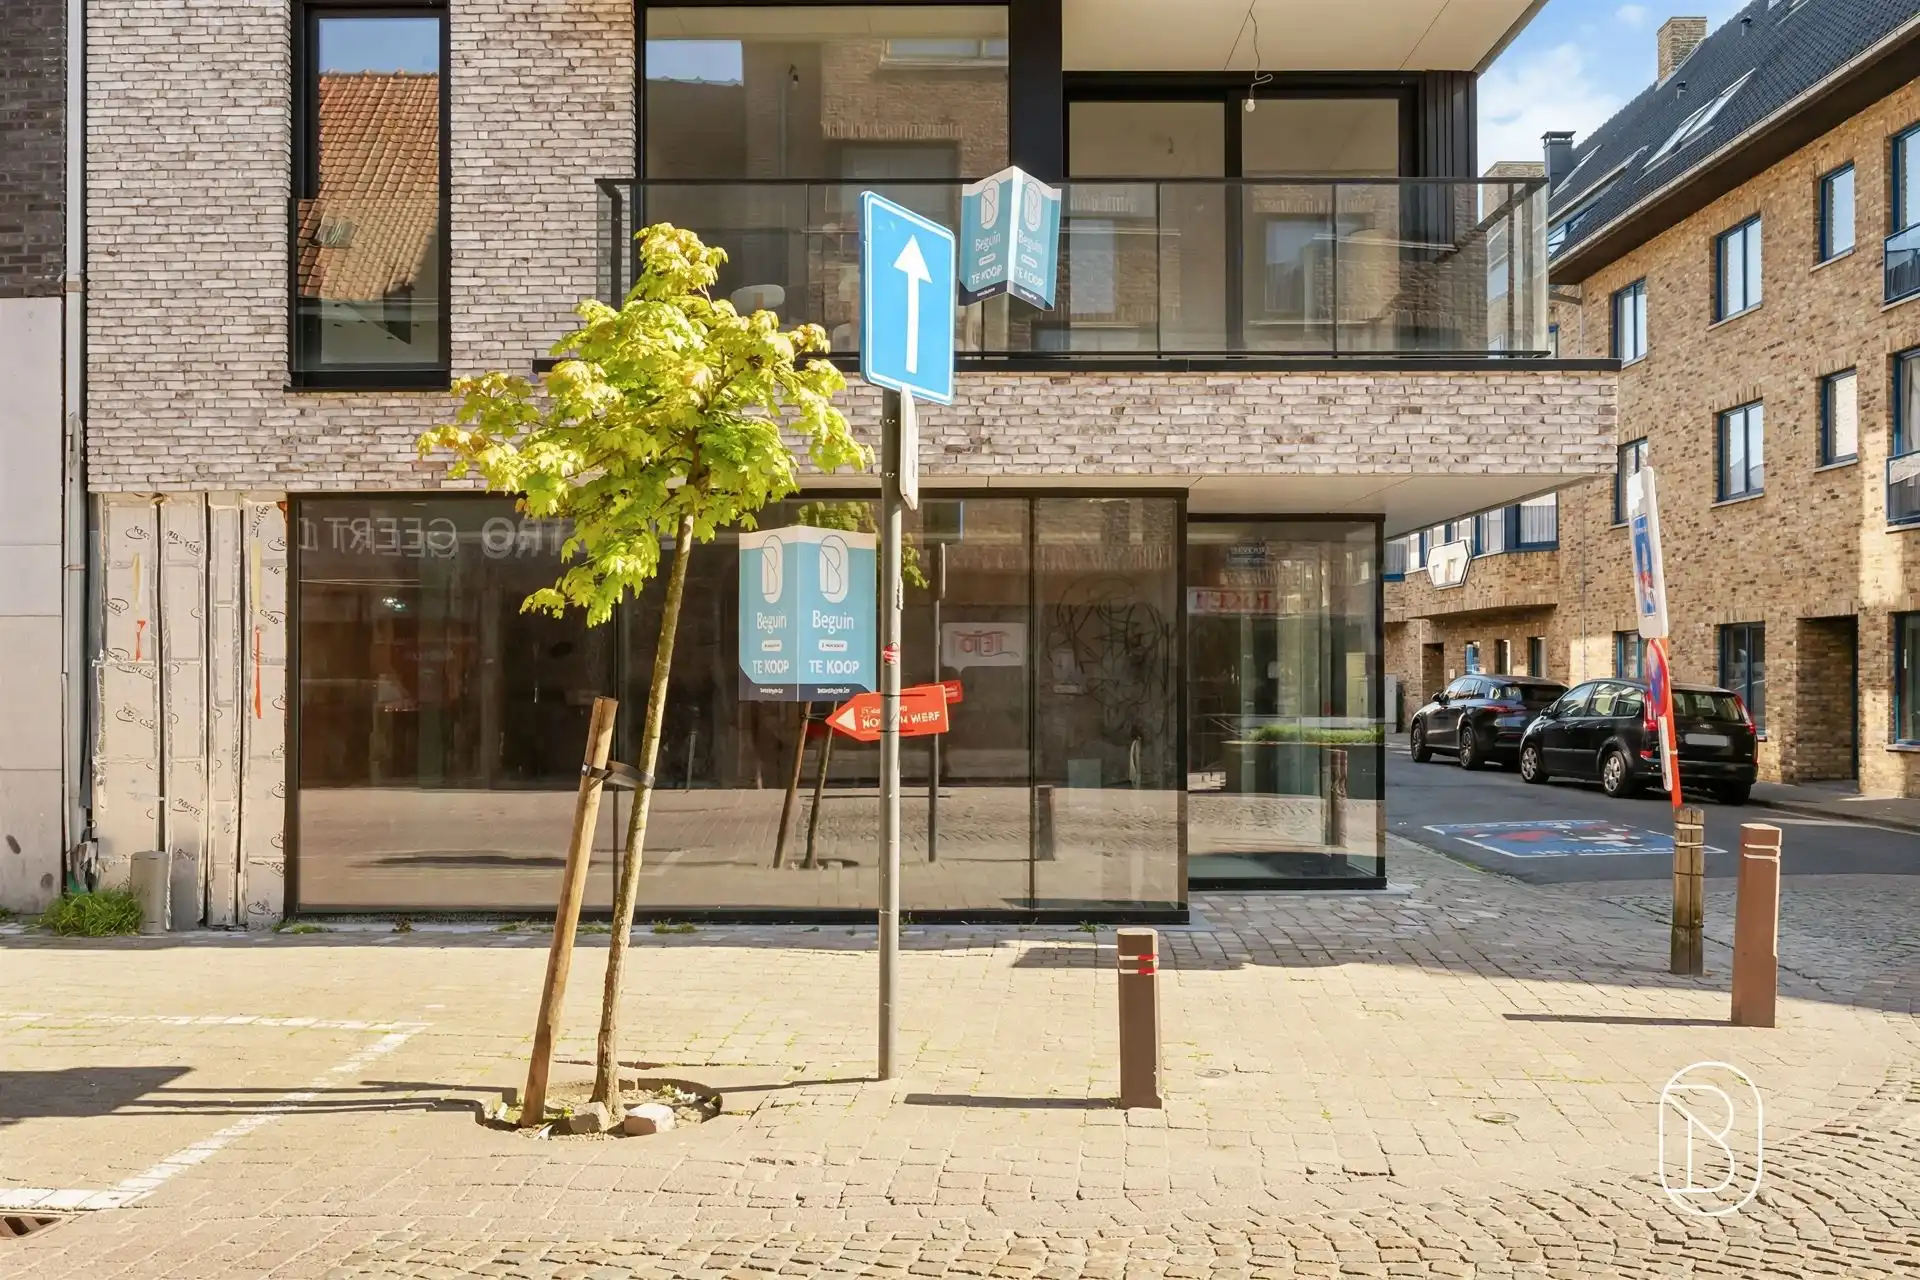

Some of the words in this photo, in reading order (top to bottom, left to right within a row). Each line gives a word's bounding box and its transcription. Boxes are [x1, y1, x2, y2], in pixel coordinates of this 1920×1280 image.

[975, 230, 1001, 252] Beguin
[971, 272, 980, 284] TE
[981, 264, 1003, 281] KOOP
[756, 610, 787, 634] Beguin
[812, 609, 854, 635] Beguin
[752, 660, 763, 674] TE
[764, 659, 790, 675] KOOP
[808, 660, 824, 673] TE
[826, 659, 860, 675] KOOP
